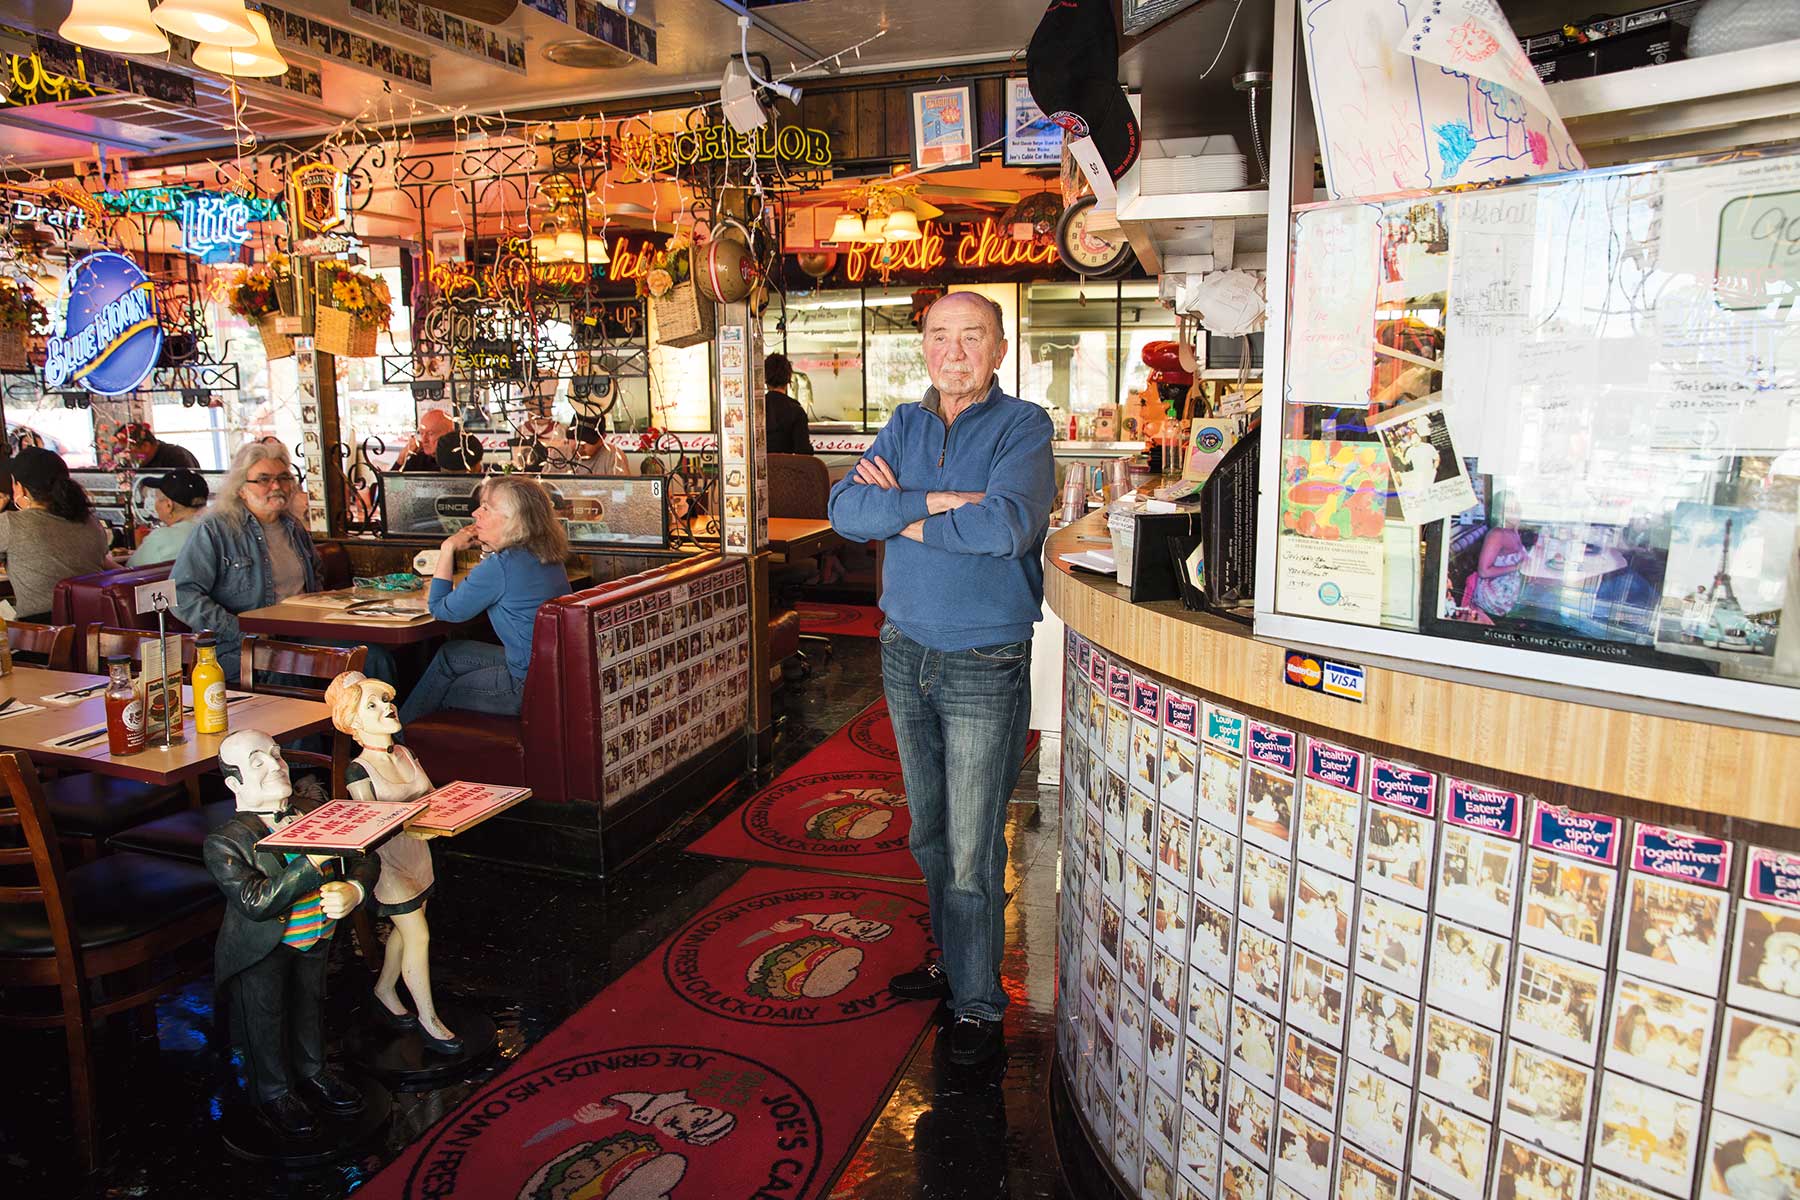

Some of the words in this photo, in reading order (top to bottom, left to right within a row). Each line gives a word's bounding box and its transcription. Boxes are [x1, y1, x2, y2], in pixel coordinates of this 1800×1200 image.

[14, 200, 86, 229] Draft
[848, 221, 945, 281] fresh
[425, 306, 536, 349] Corona
[45, 325, 98, 386] BLUE
[95, 287, 148, 350] MOON
[455, 349, 511, 368] Extra
[653, 482, 660, 496] 8
[437, 503, 469, 512] SINCE
[573, 507, 599, 515] 1977
[151, 592, 162, 601] 14
[1484, 631, 1516, 641] MICHAEL
[1287, 664, 1320, 678] MasterCard
[1331, 673, 1357, 688] VISA
[1140, 705, 1154, 716] Gallery
[1170, 701, 1192, 713] "Healthy
[1173, 711, 1191, 720] Eaters"
[1212, 712, 1233, 726] "Lousy
[1173, 720, 1191, 732] Gallery
[1213, 734, 1235, 746] Gallery
[1258, 751, 1284, 763] Gallery
[1314, 748, 1353, 763] "Healthy
[1320, 759, 1351, 772] Eaters"
[1320, 770, 1350, 785] Gallery
[1388, 767, 1412, 780] "Get
[437, 785, 467, 798] WAIT
[448, 786, 486, 803] SEATED
[1384, 791, 1418, 806] Gallery
[1457, 789, 1508, 805] "Healthy
[435, 803, 473, 818] THANK
[471, 792, 495, 801] YOU
[1465, 802, 1506, 815] Eaters"
[282, 819, 321, 838] DON'T
[316, 804, 348, 819] LOOK
[332, 825, 359, 835] THE
[352, 810, 382, 824] BOSS
[1464, 814, 1506, 829] Gallery
[1552, 813, 1597, 831] "Lousy
[304, 832, 324, 840] AT
[874, 837, 904, 849] AR
[1660, 834, 1696, 849] "Get
[1552, 839, 1600, 856] Gallery
[1652, 861, 1705, 877] Gallery
[748, 891, 825, 911] GRINDS
[829, 890, 865, 902] JOE
[716, 903, 748, 922] HIS
[684, 920, 720, 944] OWN
[673, 941, 701, 981] FRESH
[684, 980, 752, 1016] CHUCK
[751, 1004, 821, 1020] DAILY
[554, 1051, 660, 1083] GRINDS
[665, 1051, 717, 1071] JOE
[503, 1074, 554, 1103] HIS
[449, 1099, 511, 1143] OWN
[761, 1091, 804, 1150] JOE'S
